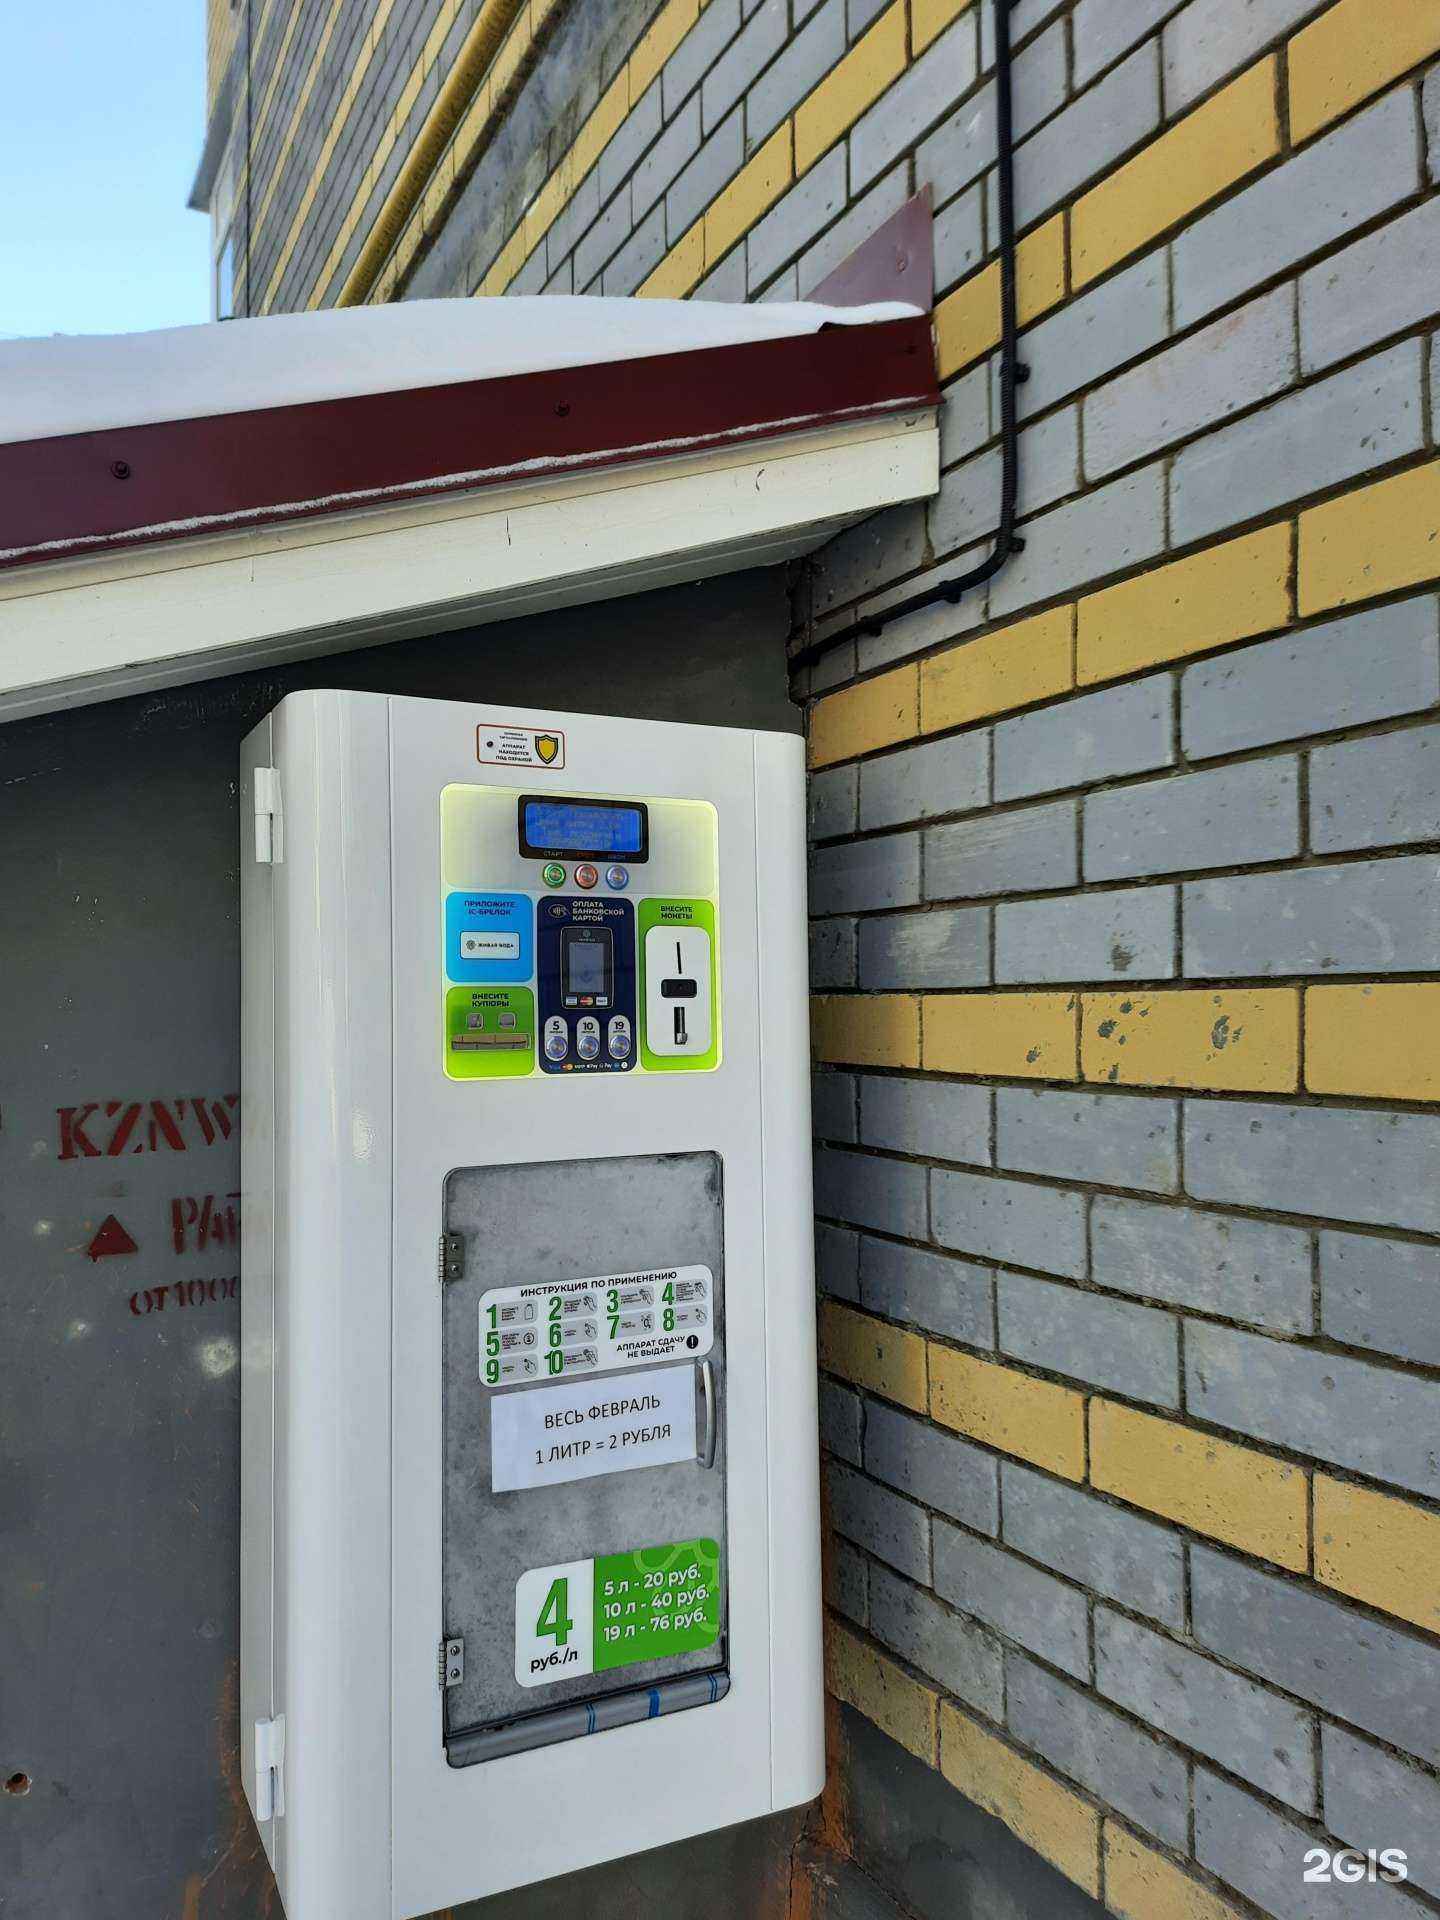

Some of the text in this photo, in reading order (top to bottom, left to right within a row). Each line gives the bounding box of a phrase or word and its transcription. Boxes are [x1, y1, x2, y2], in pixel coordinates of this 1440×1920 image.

[572, 907, 625, 916] БАНКОВСКОЙ
[572, 914, 604, 922] КАРТОЙ
[660, 905, 693, 913] ВНЕСИТЕ
[661, 912, 693, 920] МОНЕТЫ
[472, 1000, 510, 1008] КУПЮРЫ
[552, 1020, 560, 1031] 5
[582, 1022, 594, 1031] 10
[614, 1021, 625, 1030] 19
[520, 1271, 677, 1298] ИНСТРУКЦИЯ ПО ПРИМЕНЕНИЮ
[662, 1282, 675, 1305] 4
[549, 1296, 562, 1321] 2
[606, 1289, 619, 1313] 3
[486, 1304, 497, 1329] 1
[606, 1315, 620, 1339] 7
[663, 1308, 675, 1332] 8
[486, 1331, 500, 1356] 5
[549, 1323, 562, 1347] 6
[616, 1335, 686, 1352] АППАРАТ СДАЧУ
[544, 1350, 564, 1375] 10
[627, 1345, 676, 1358] НЕ ВЫДАЕТ
[486, 1359, 499, 1384] 9
[544, 1395, 661, 1429] ВЕСЬ ФЕВРАЛЬ
[535, 1450, 544, 1464] 1
[548, 1440, 591, 1462] ЛИТР
[609, 1434, 618, 1449] 2
[622, 1424, 671, 1447] РУБЛЯ
[604, 1581, 614, 1596] 5
[618, 1581, 629, 1593] л
[644, 1572, 664, 1589] 20
[668, 1563, 702, 1587] руб.
[536, 1577, 573, 1646] 4
[603, 1603, 621, 1619] 10
[625, 1603, 636, 1616] л
[651, 1591, 672, 1609] 40
[677, 1584, 710, 1607] руб.
[603, 1625, 621, 1642] 19
[625, 1626, 636, 1639] л
[650, 1615, 670, 1632] 76
[674, 1607, 707, 1630] руб.
[530, 1649, 578, 1673] руб./л
